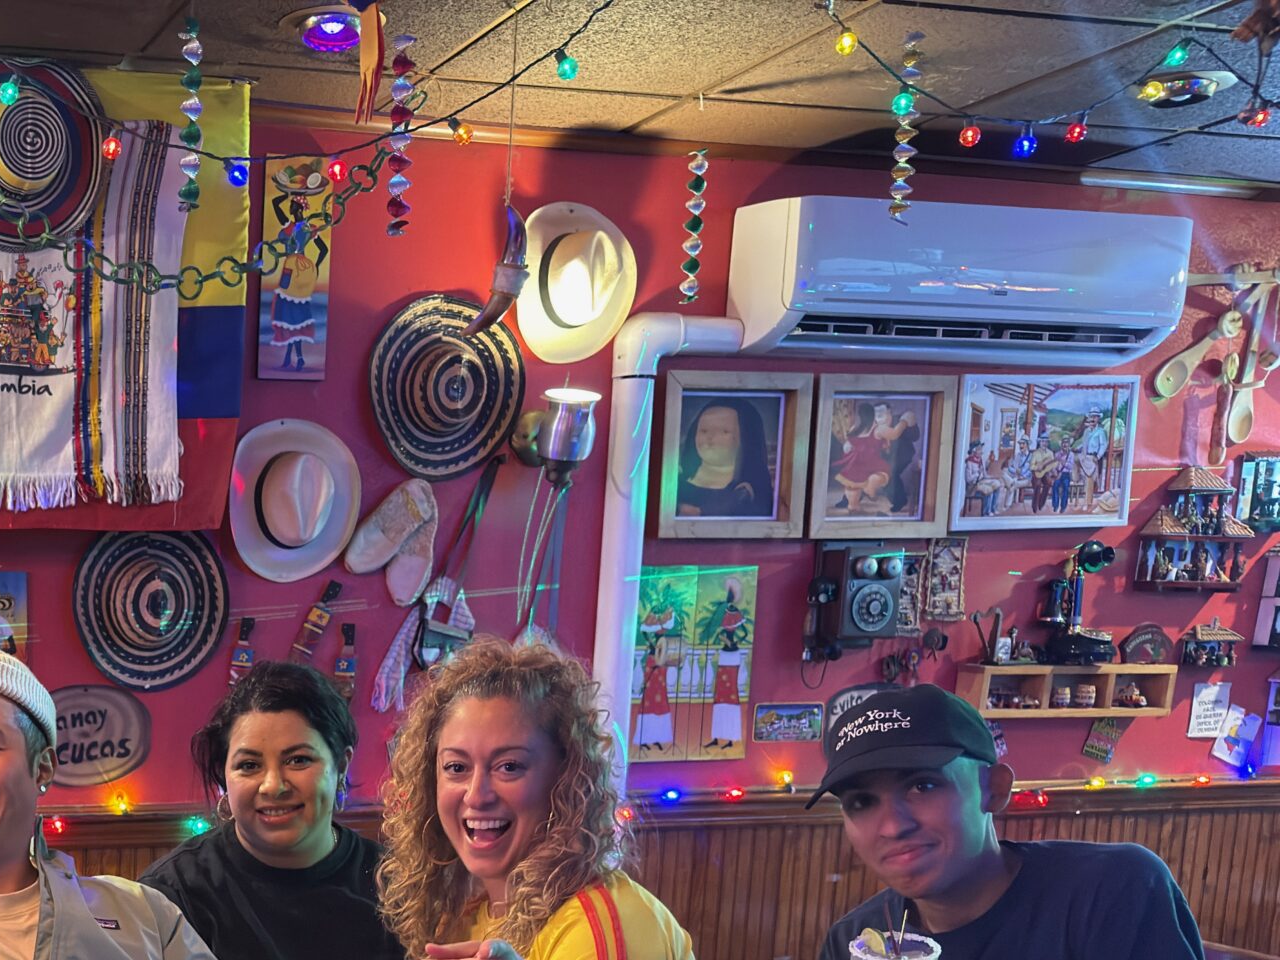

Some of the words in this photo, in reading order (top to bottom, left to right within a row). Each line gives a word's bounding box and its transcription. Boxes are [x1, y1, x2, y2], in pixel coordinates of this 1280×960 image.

[838, 716, 865, 737] New
[866, 708, 911, 721] York
[847, 720, 911, 742] Nowhere
